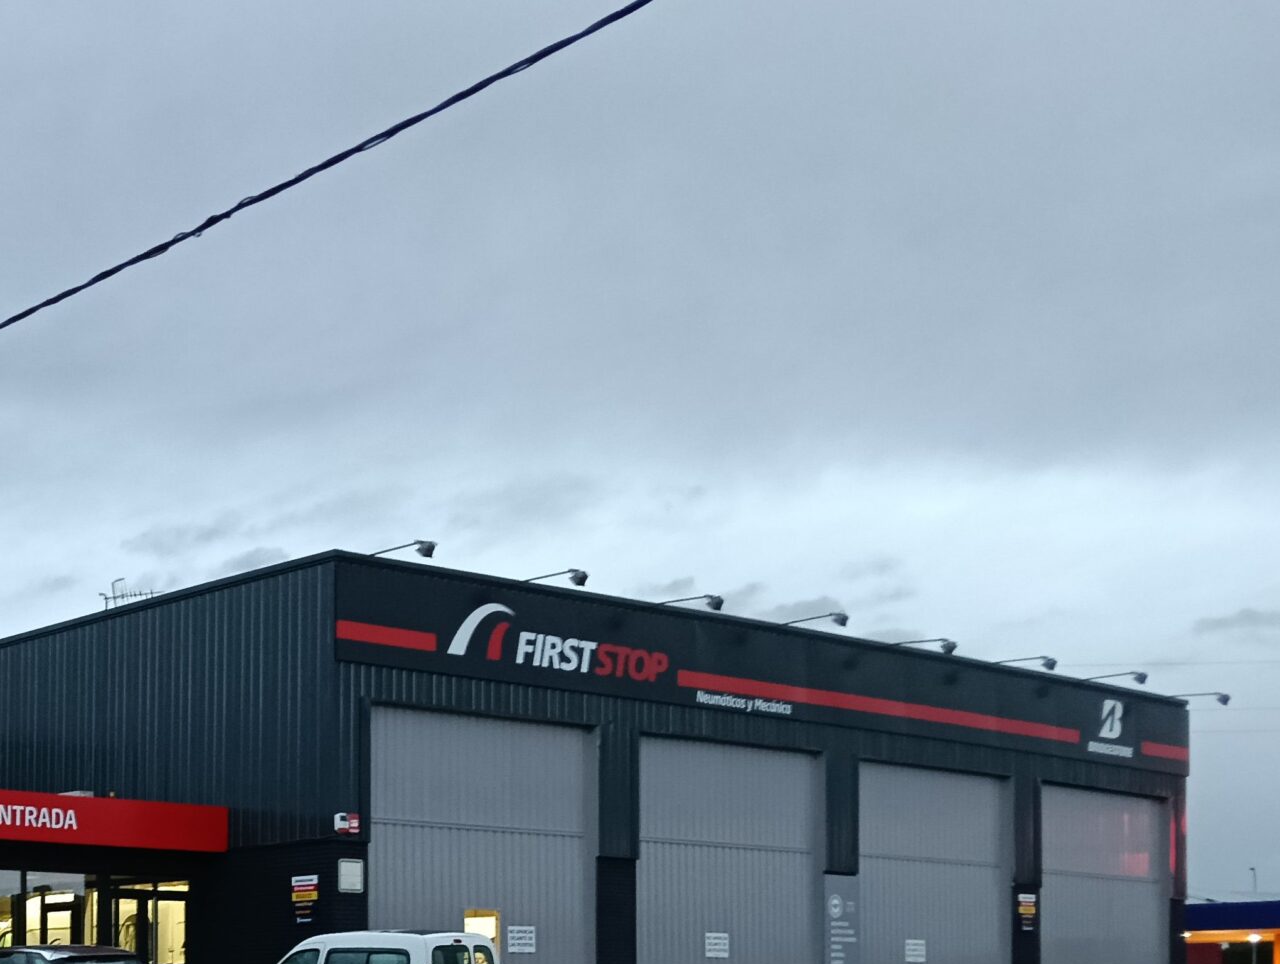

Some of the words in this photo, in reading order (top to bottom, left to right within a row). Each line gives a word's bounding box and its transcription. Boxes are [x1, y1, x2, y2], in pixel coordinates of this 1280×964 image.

[696, 690, 746, 709] Neumáticos
[746, 699, 754, 712] y
[754, 698, 793, 714] Mecánica
